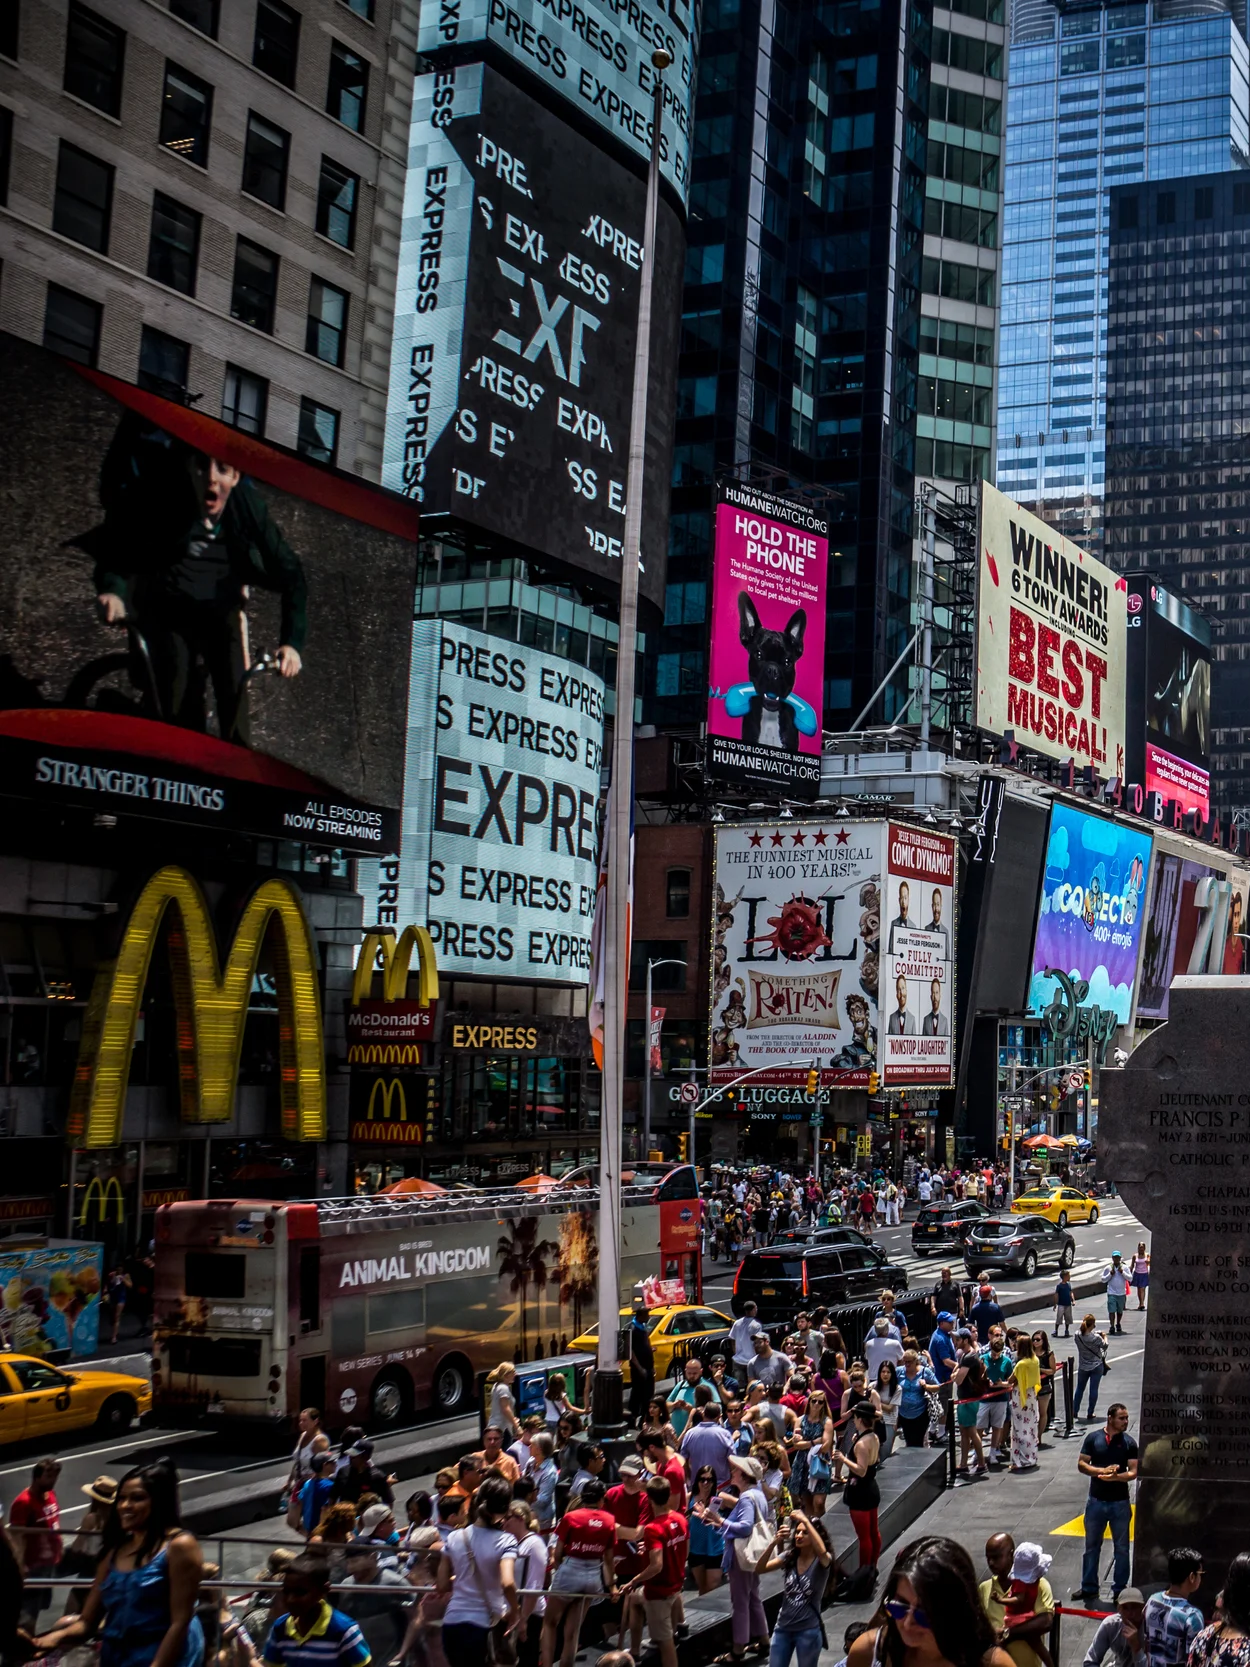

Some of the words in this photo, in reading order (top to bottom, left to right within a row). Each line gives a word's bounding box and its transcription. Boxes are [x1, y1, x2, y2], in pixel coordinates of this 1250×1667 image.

[416, 166, 448, 314] EXPRESS
[726, 487, 827, 533] HUMANEWATCH.ORG
[735, 514, 782, 547] HOLD
[786, 532, 816, 560] THE
[747, 540, 804, 577] PHONE
[730, 558, 741, 568] The
[742, 562, 764, 576] Humane
[765, 569, 784, 583] Society
[785, 576, 791, 584] of
[792, 578, 800, 587] the
[801, 581, 818, 593] United
[1009, 519, 1108, 622] WINNER!
[755, 586, 767, 597] local
[768, 591, 777, 601] pet
[778, 594, 801, 607] shelters?
[1155, 590, 1163, 604] LG
[1011, 571, 1021, 593] 6
[1022, 576, 1058, 614] TONY
[1059, 599, 1109, 646] AWARDS
[1049, 616, 1076, 638] INCLUDING
[1127, 616, 1141, 628] LG
[1008, 605, 1108, 720] BEST
[1007, 682, 1107, 763] MUSICAL!
[713, 739, 727, 748] GIVE
[728, 741, 736, 750] TO
[737, 743, 752, 753] YOUR
[752, 746, 769, 757] LOCAL
[793, 755, 803, 763] NOT
[713, 749, 820, 782] HUMANEWATCH.ORG
[35, 756, 150, 799] STRANGER
[150, 777, 225, 811] THINGS
[857, 794, 893, 802] LAMAR
[305, 801, 327, 818] ALL
[329, 805, 382, 827] EPISODES
[283, 813, 314, 831] NOW
[316, 819, 382, 841] STREAMING
[726, 851, 750, 864] THE
[753, 849, 814, 863] FUNNIEST
[817, 848, 873, 861] MUSICAL
[892, 842, 915, 869] COMIC
[747, 865, 764, 879] IN
[768, 865, 796, 879] 400
[896, 937, 908, 946] JESSE
[908, 939, 921, 947] TYLER
[920, 941, 941, 950] FERGUSON
[1094, 926, 1111, 942] 400+
[1112, 932, 1132, 949] emojis
[907, 950, 932, 964] FULLY
[895, 962, 944, 978] COMMITTED
[762, 975, 828, 987] SOMETHING
[348, 1013, 430, 1026] McDonald's
[361, 1028, 415, 1037] Restaurant
[452, 1025, 538, 1050] EXPRESS
[765, 1047, 787, 1055] BOOK
[800, 1047, 836, 1055] MORMON
[1160, 1093, 1234, 1106] LIEUTENANT
[1169, 1154, 1234, 1166] CATHOLIC
[338, 1255, 411, 1288] ANIMAL
[415, 1246, 490, 1277] KINGDOM
[1170, 1255, 1179, 1266] A
[1184, 1255, 1211, 1266] LIFE
[1215, 1256, 1232, 1267] OF
[1217, 1269, 1238, 1279] FOR
[1164, 1281, 1194, 1292] GOD
[1199, 1282, 1226, 1293] AND
[212, 1307, 240, 1317] ANIMAL
[1161, 1314, 1204, 1324] SPANISH
[1147, 1329, 1171, 1339] NEW
[1175, 1330, 1204, 1340] YORK
[1177, 1346, 1229, 1357] MEXICAN
[1189, 1361, 1231, 1372] WORLD
[1143, 1393, 1224, 1405] DISTINGUISHED
[1143, 1408, 1224, 1420] DISTINGUISHED
[1143, 1424, 1222, 1435] CONSPICUOUS
[1171, 1440, 1211, 1451] LEGION
[1171, 1456, 1207, 1466] CROIX
[1215, 1457, 1230, 1467] DE
